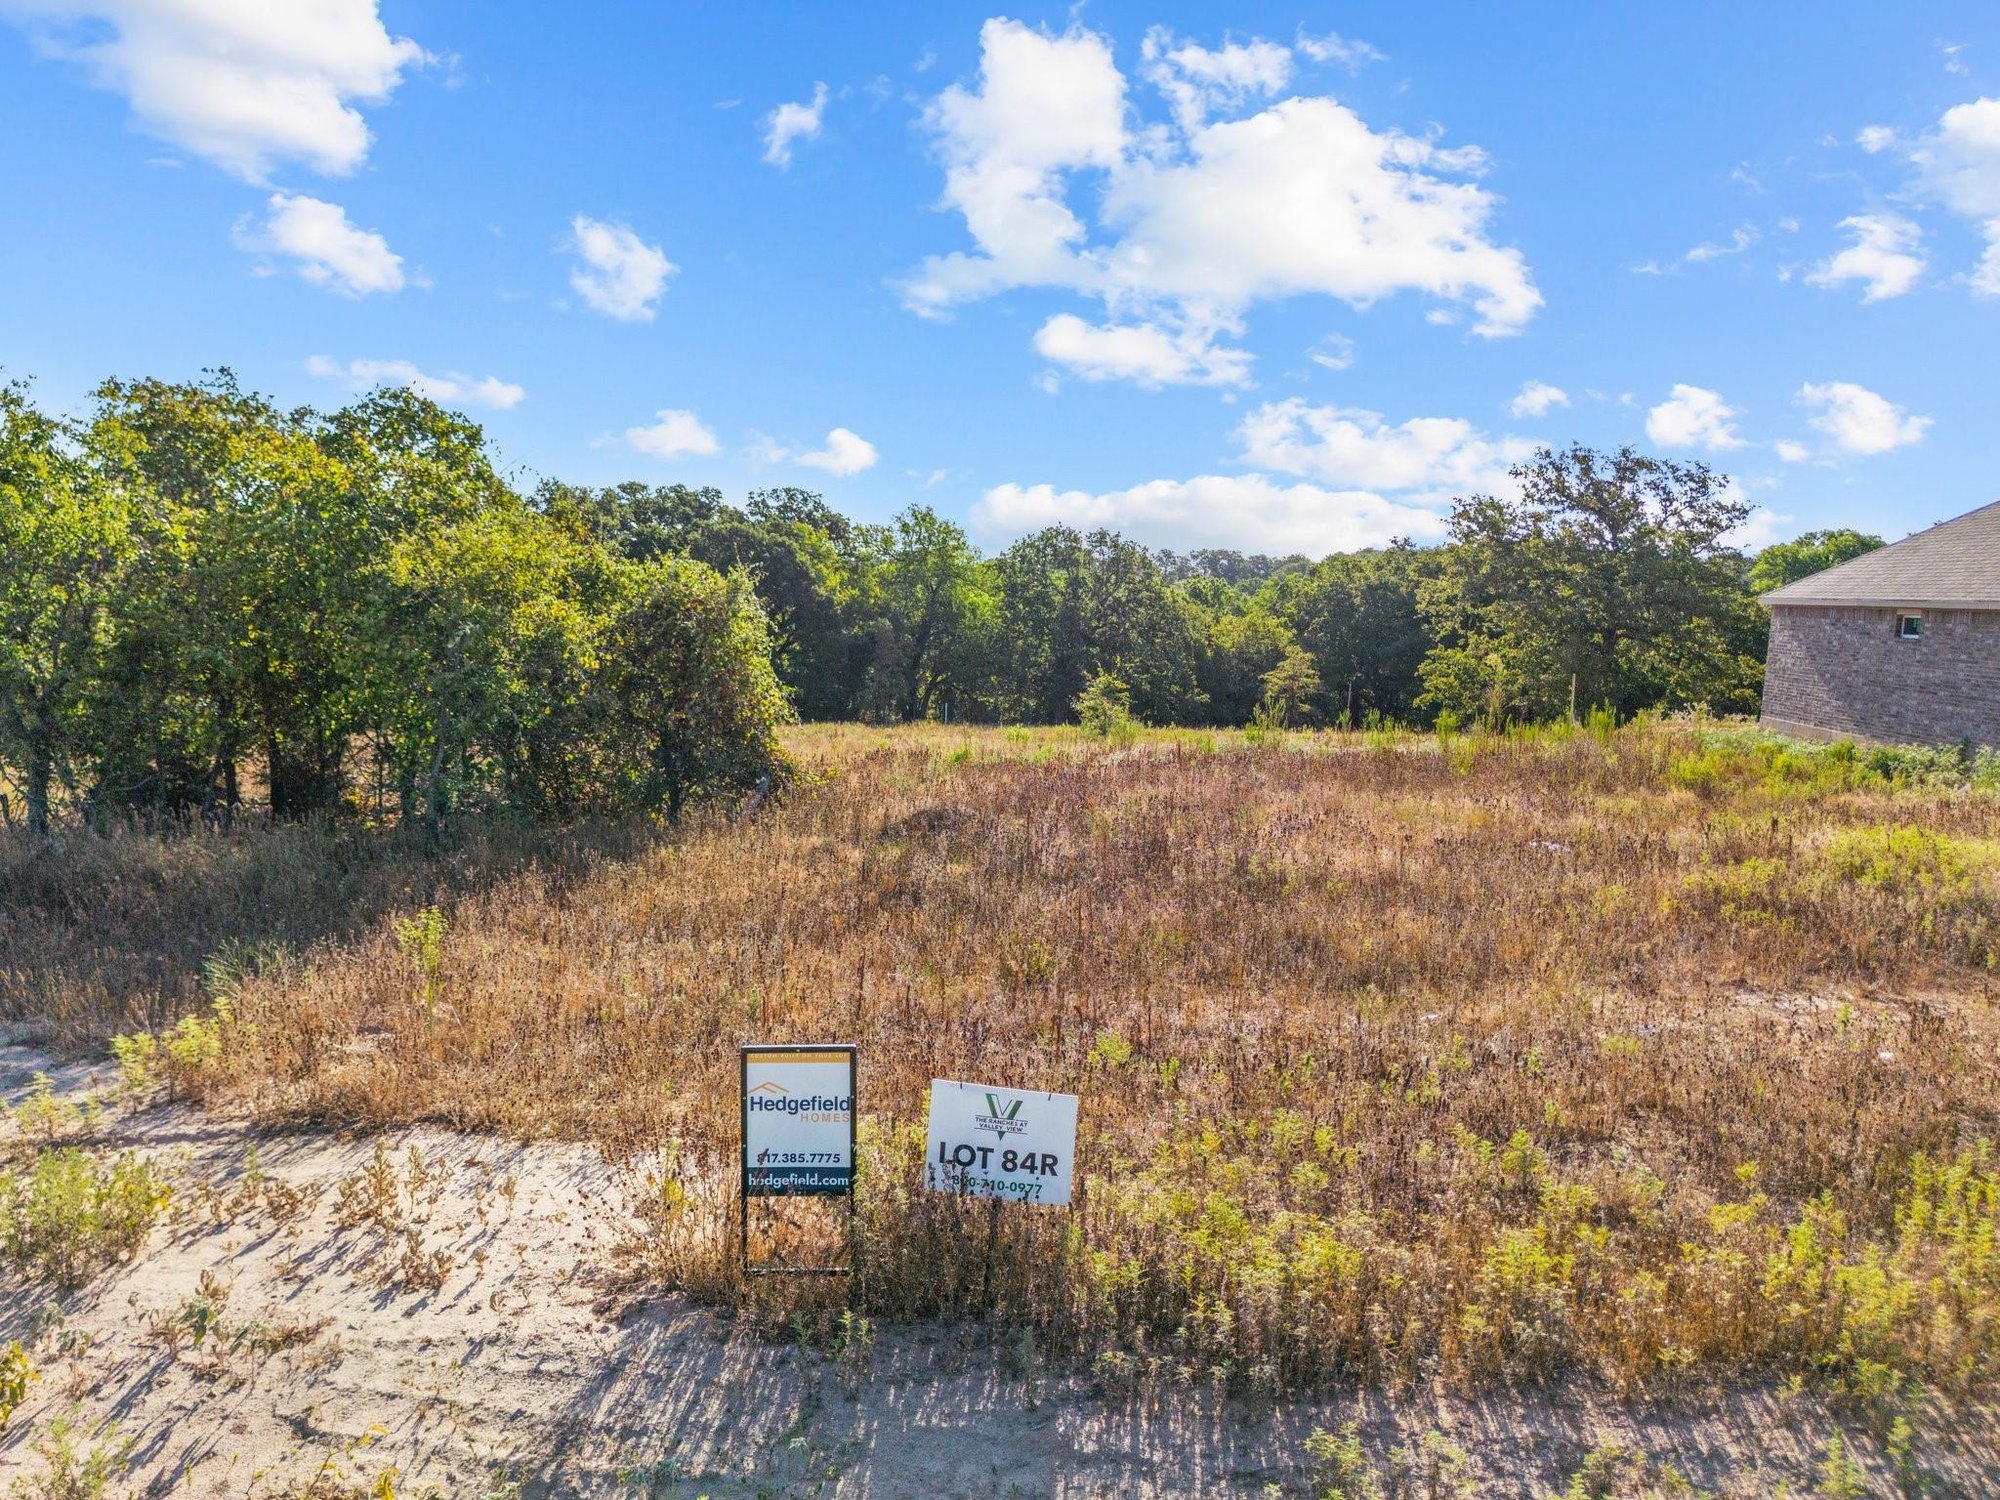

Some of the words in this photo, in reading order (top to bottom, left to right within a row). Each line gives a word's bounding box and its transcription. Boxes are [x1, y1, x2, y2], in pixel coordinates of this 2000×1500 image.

[750, 1096, 851, 1115] Hedgefield
[801, 1113, 850, 1123] HOMES
[988, 1119, 1018, 1127] RANCHES
[1001, 1150, 1058, 1176] 84R
[748, 1173, 849, 1188] hedgefield.com
[952, 1175, 1042, 1194] 80-710-0977
